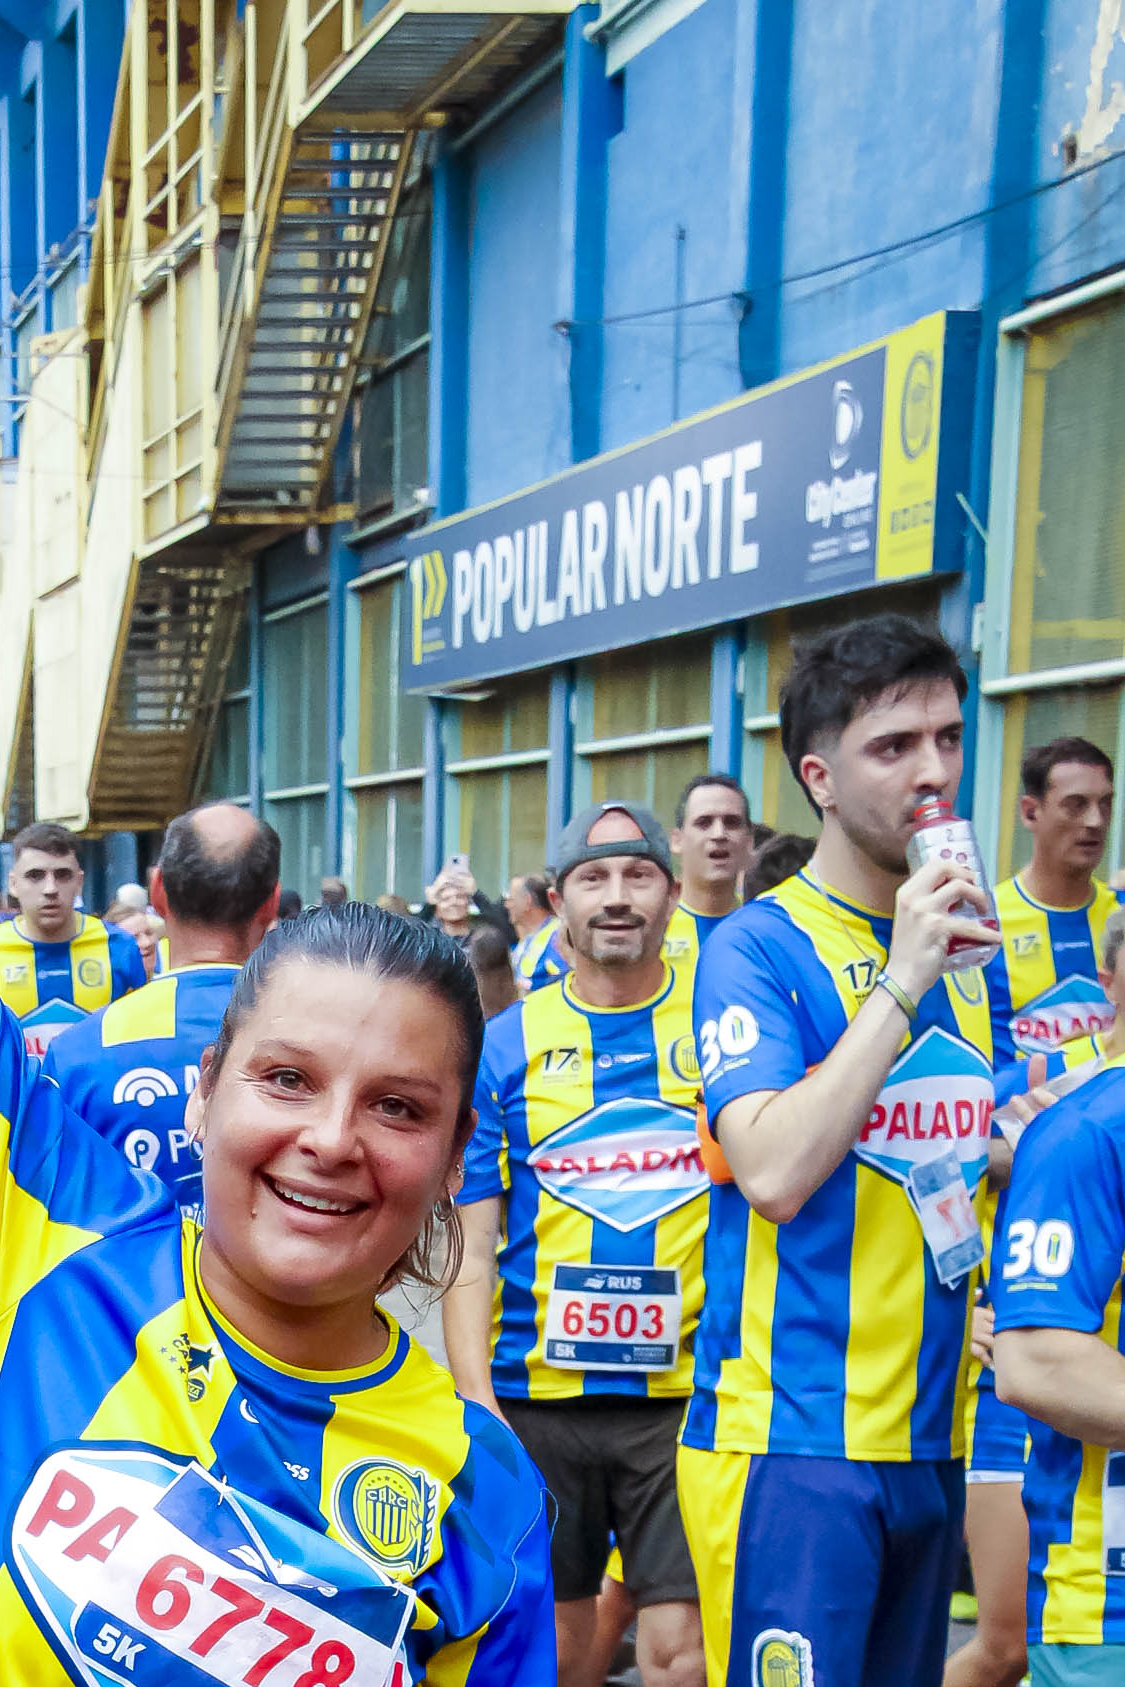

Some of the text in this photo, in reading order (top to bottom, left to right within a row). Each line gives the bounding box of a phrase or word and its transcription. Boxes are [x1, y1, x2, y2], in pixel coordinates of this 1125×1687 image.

[452, 500, 608, 649] POPULAR
[614, 440, 763, 605] NORTE
[842, 959, 877, 990] 17
[541, 1046, 580, 1071] 17
[1002, 1218, 1075, 1280] 30
[607, 1275, 643, 1291] RUS
[562, 1300, 665, 1341] 6503
[92, 1622, 146, 1672] 5K
